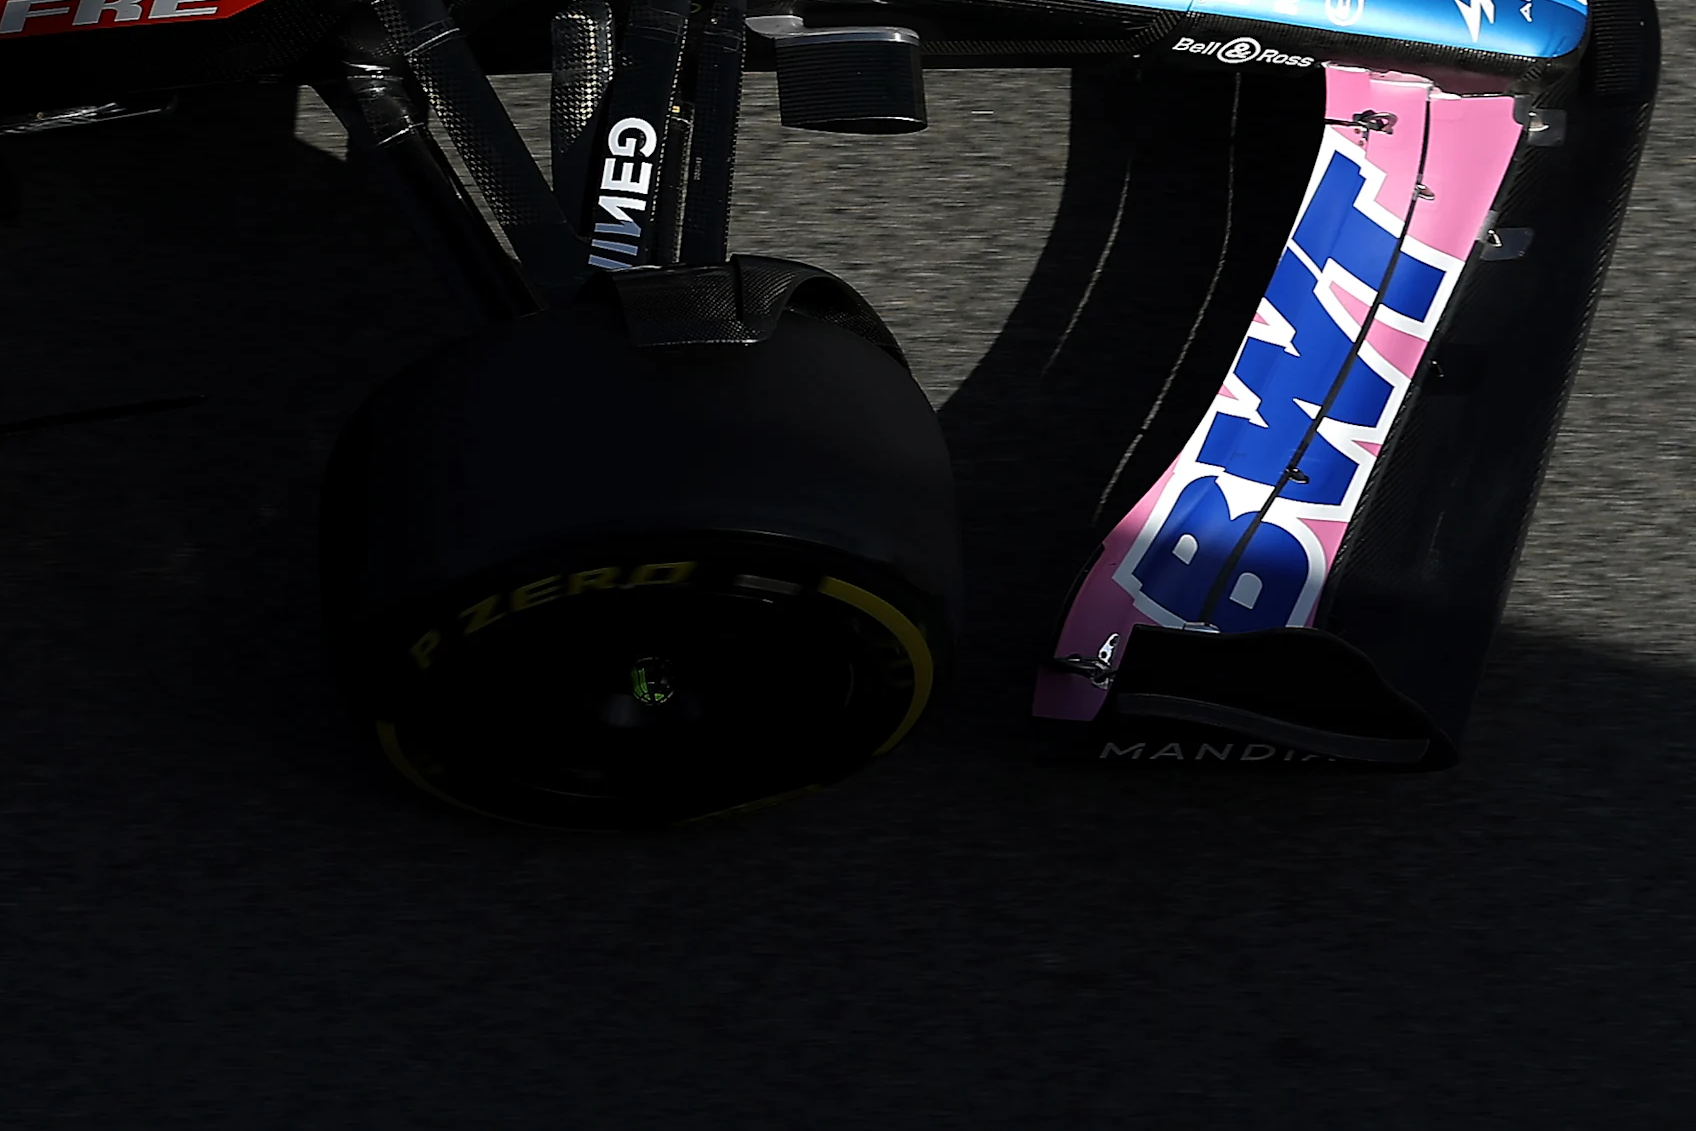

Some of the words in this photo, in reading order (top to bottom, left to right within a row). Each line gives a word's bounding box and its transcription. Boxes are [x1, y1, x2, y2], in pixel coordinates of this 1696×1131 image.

[1172, 37, 1221, 58] Bell
[1259, 48, 1314, 68] Ross
[1124, 140, 1454, 631] BWT
[408, 627, 442, 671] P
[456, 561, 700, 636] ZERO
[1099, 742, 1337, 762] MANDI
